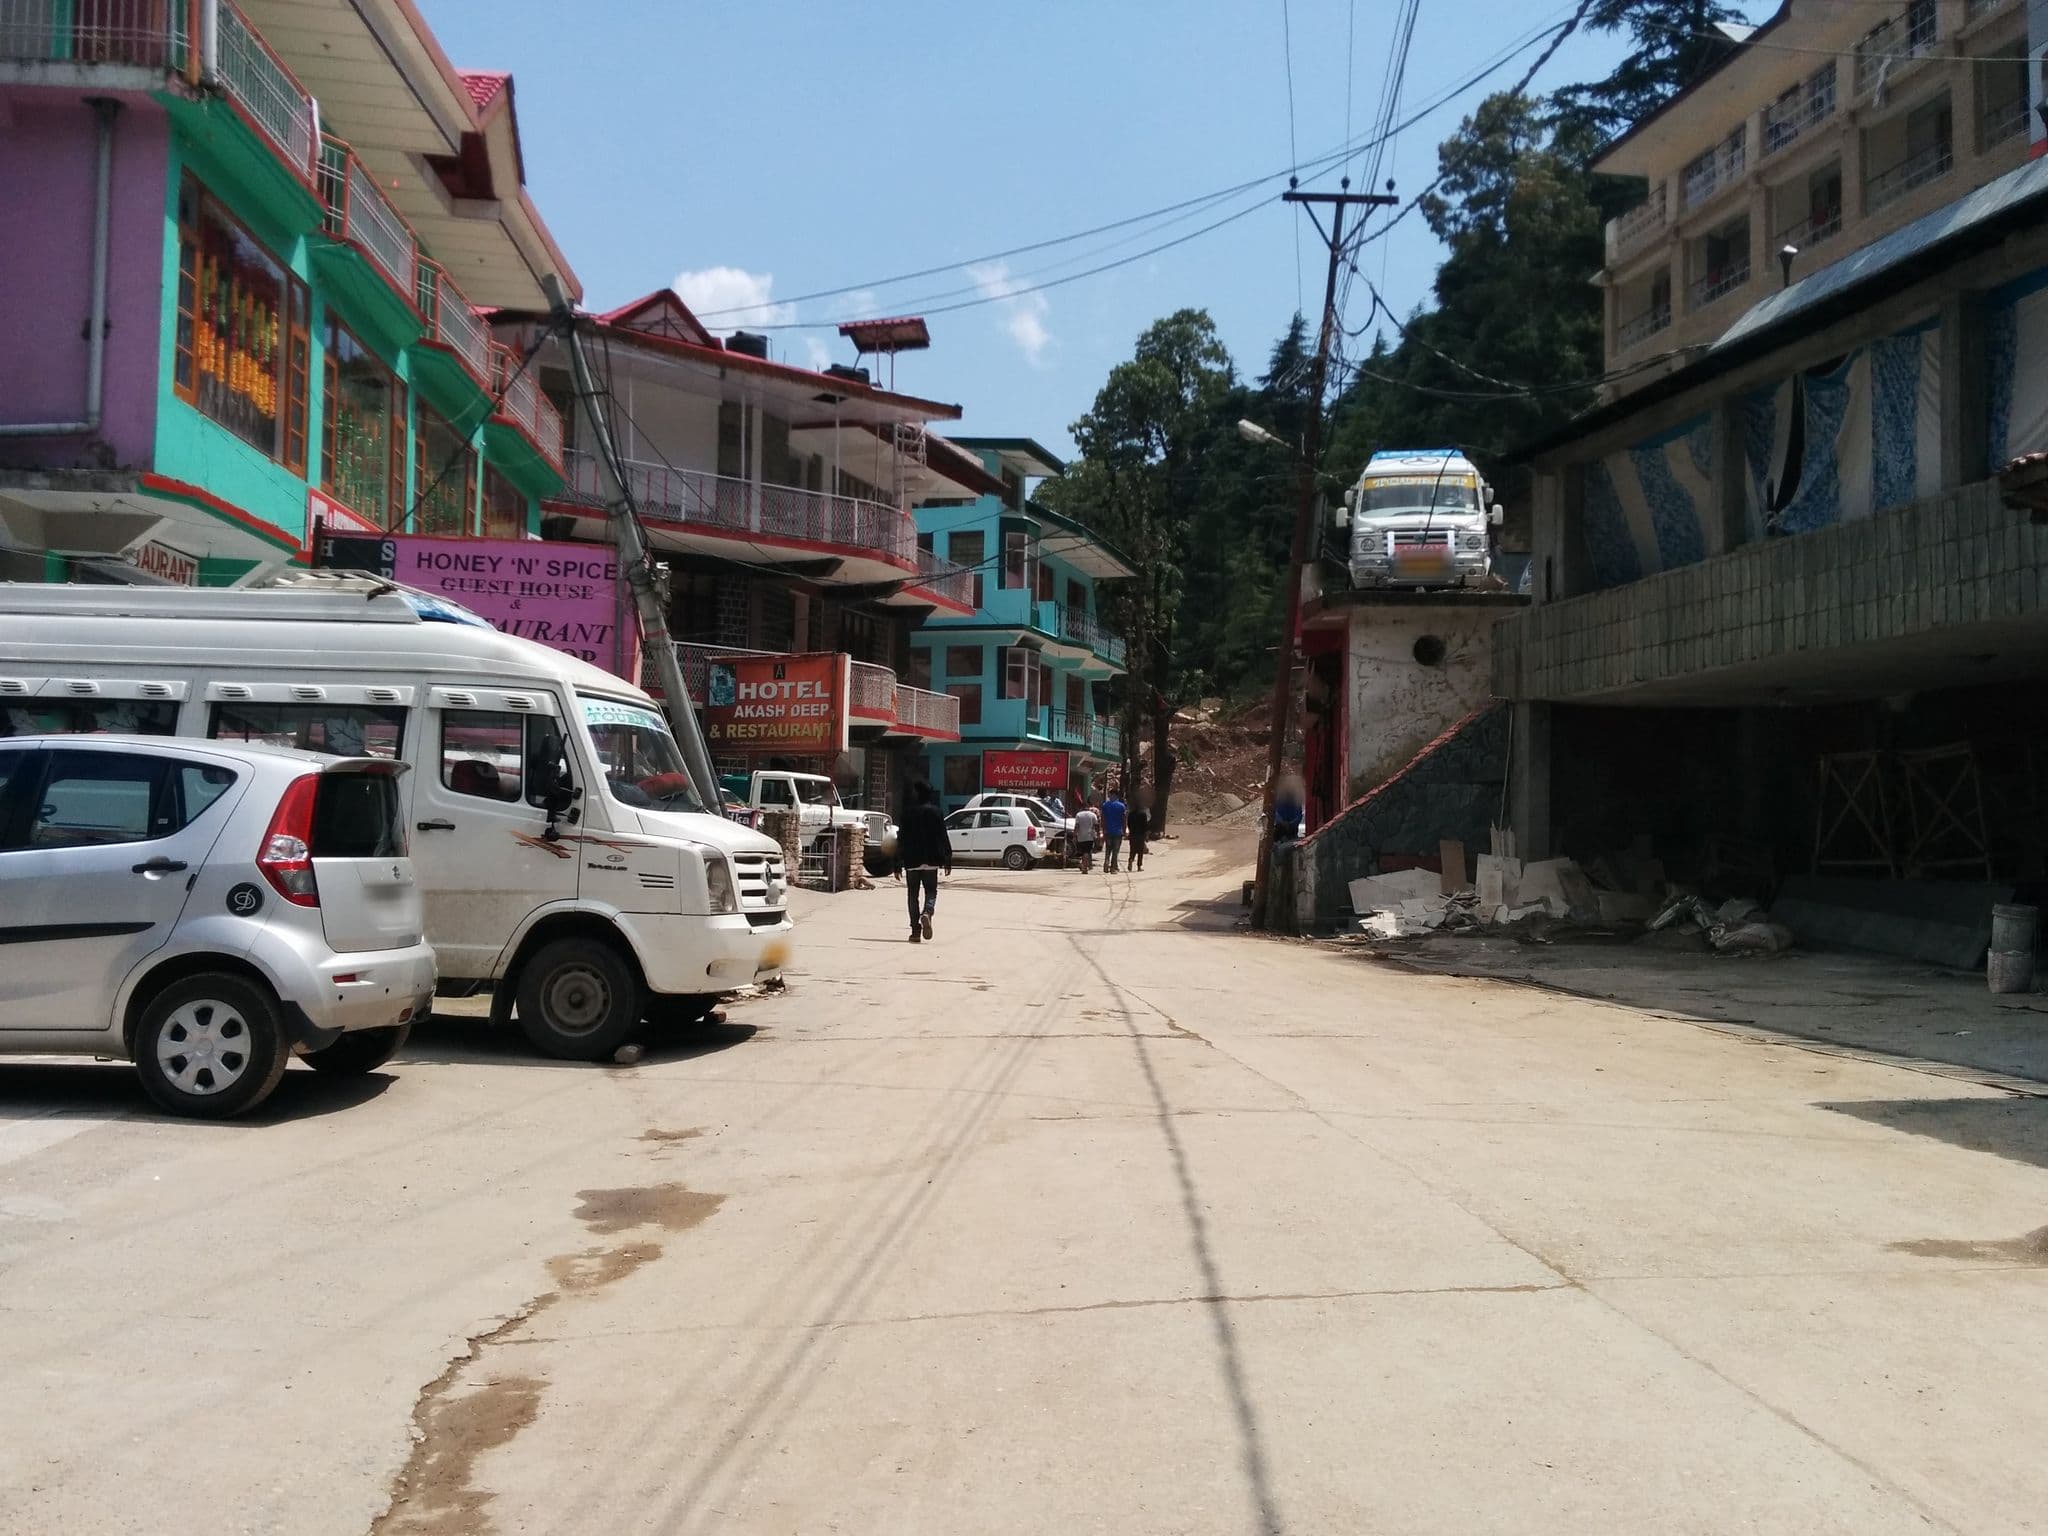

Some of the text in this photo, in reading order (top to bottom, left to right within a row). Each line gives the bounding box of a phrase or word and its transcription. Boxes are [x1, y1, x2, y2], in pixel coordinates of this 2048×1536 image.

[416, 551, 503, 574] HONEY
[546, 559, 618, 581] SPICE
[440, 576, 594, 600] GUEST HOUSE
[509, 599, 522, 610] &
[738, 680, 830, 700] HOTEL
[733, 703, 830, 719] AKASH DEEP
[709, 722, 833, 739] & RESTAURANT
[993, 765, 1058, 775] AKASH DEEP
[998, 779, 1052, 788] RESTAURANT
